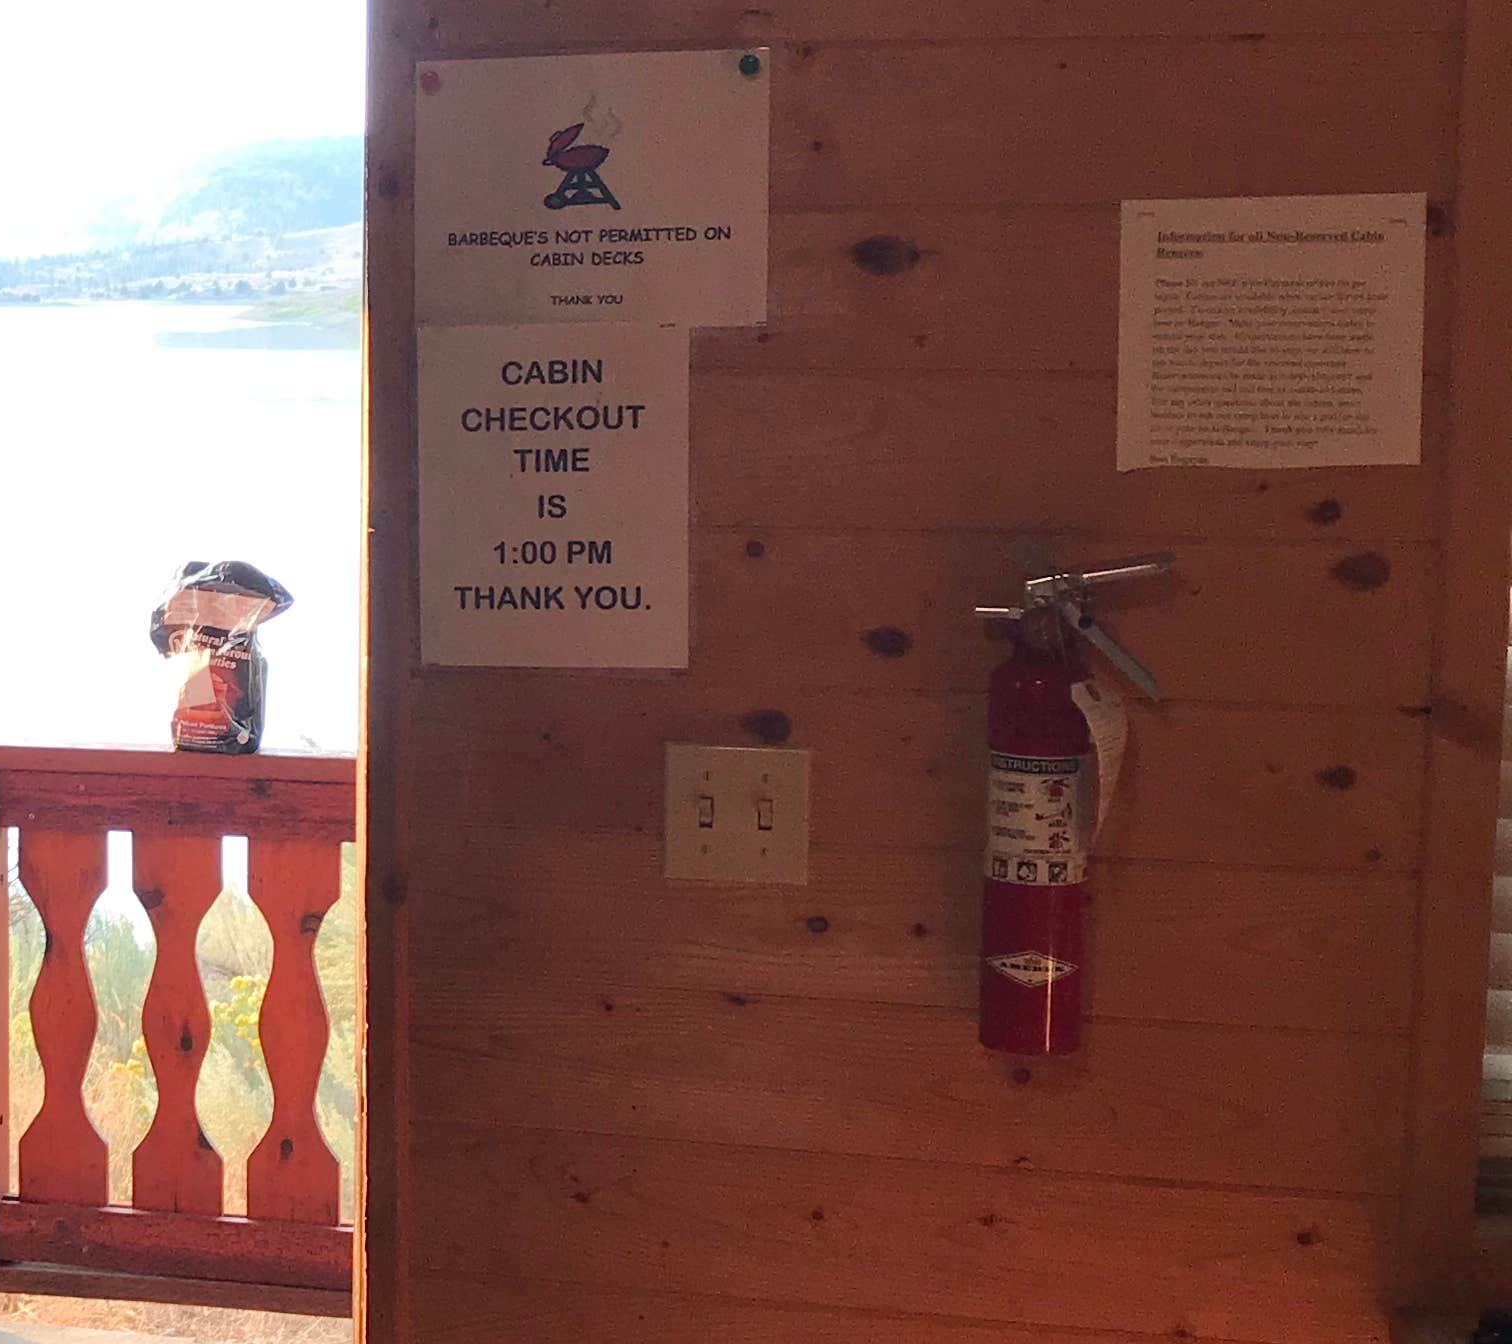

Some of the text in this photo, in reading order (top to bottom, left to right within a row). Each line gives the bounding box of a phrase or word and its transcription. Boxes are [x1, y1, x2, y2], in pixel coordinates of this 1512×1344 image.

[448, 225, 732, 248] BARBEQUE'S NOT PERMITTED ON
[529, 250, 645, 267] CABIN DECKS
[550, 293, 624, 307] THANK YOU
[500, 358, 603, 386] CABIN
[460, 404, 646, 433] CHECKOUT
[513, 448, 590, 473] TIME
[537, 494, 568, 519] IS
[493, 539, 612, 565] 1:00 PM
[454, 585, 652, 611] THANK YOU.
